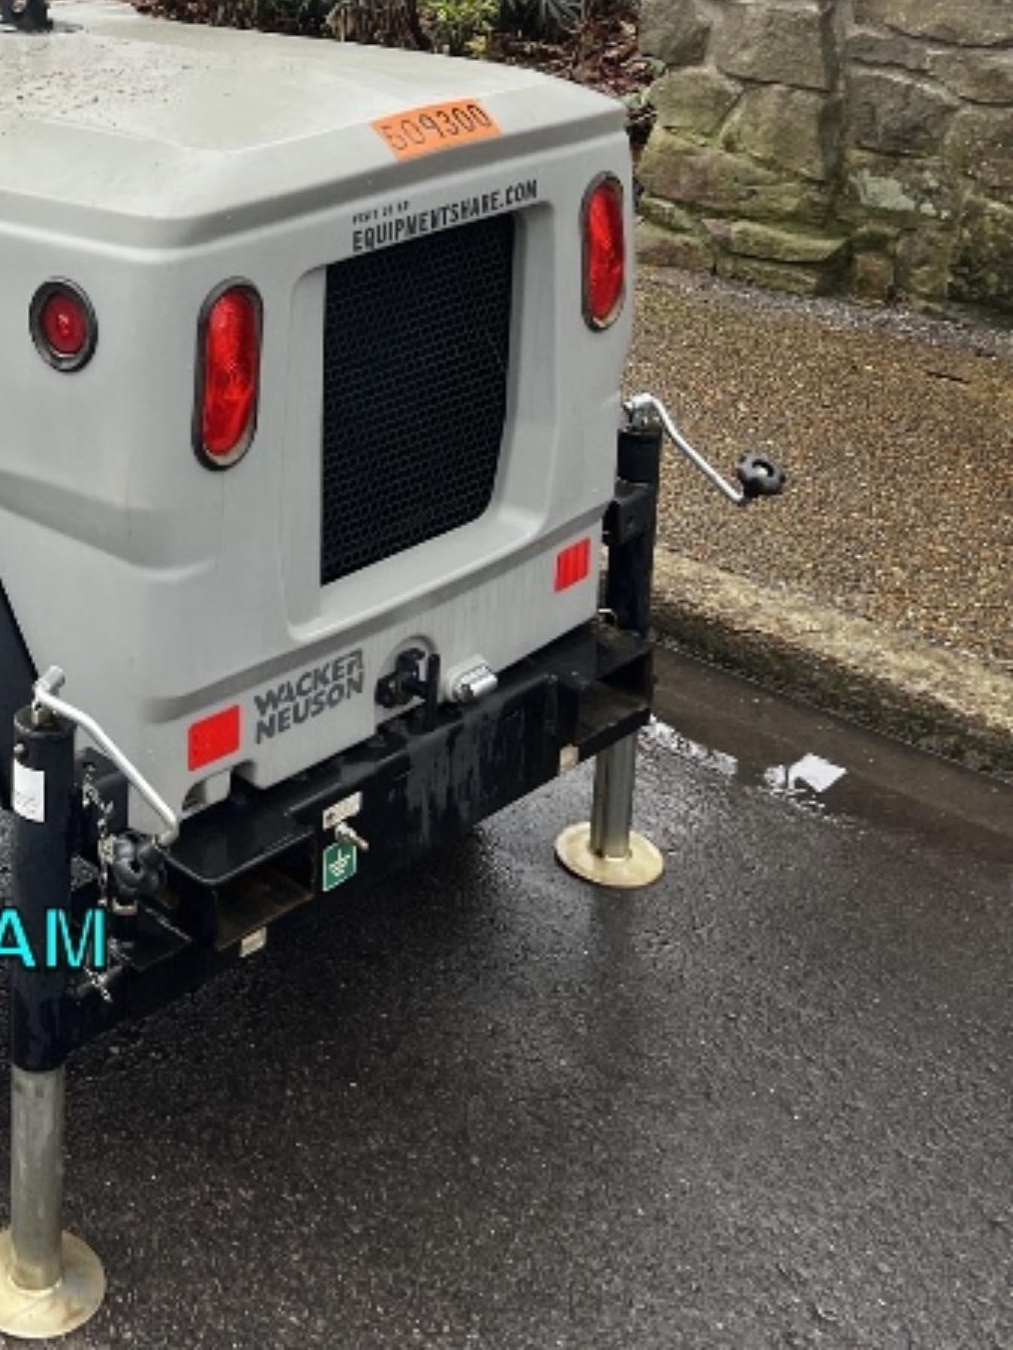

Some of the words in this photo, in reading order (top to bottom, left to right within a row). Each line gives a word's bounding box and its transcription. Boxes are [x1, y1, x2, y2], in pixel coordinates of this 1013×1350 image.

[379, 104, 492, 151] 509300
[253, 648, 364, 716] WACKER
[255, 671, 363, 745] NEUSON
